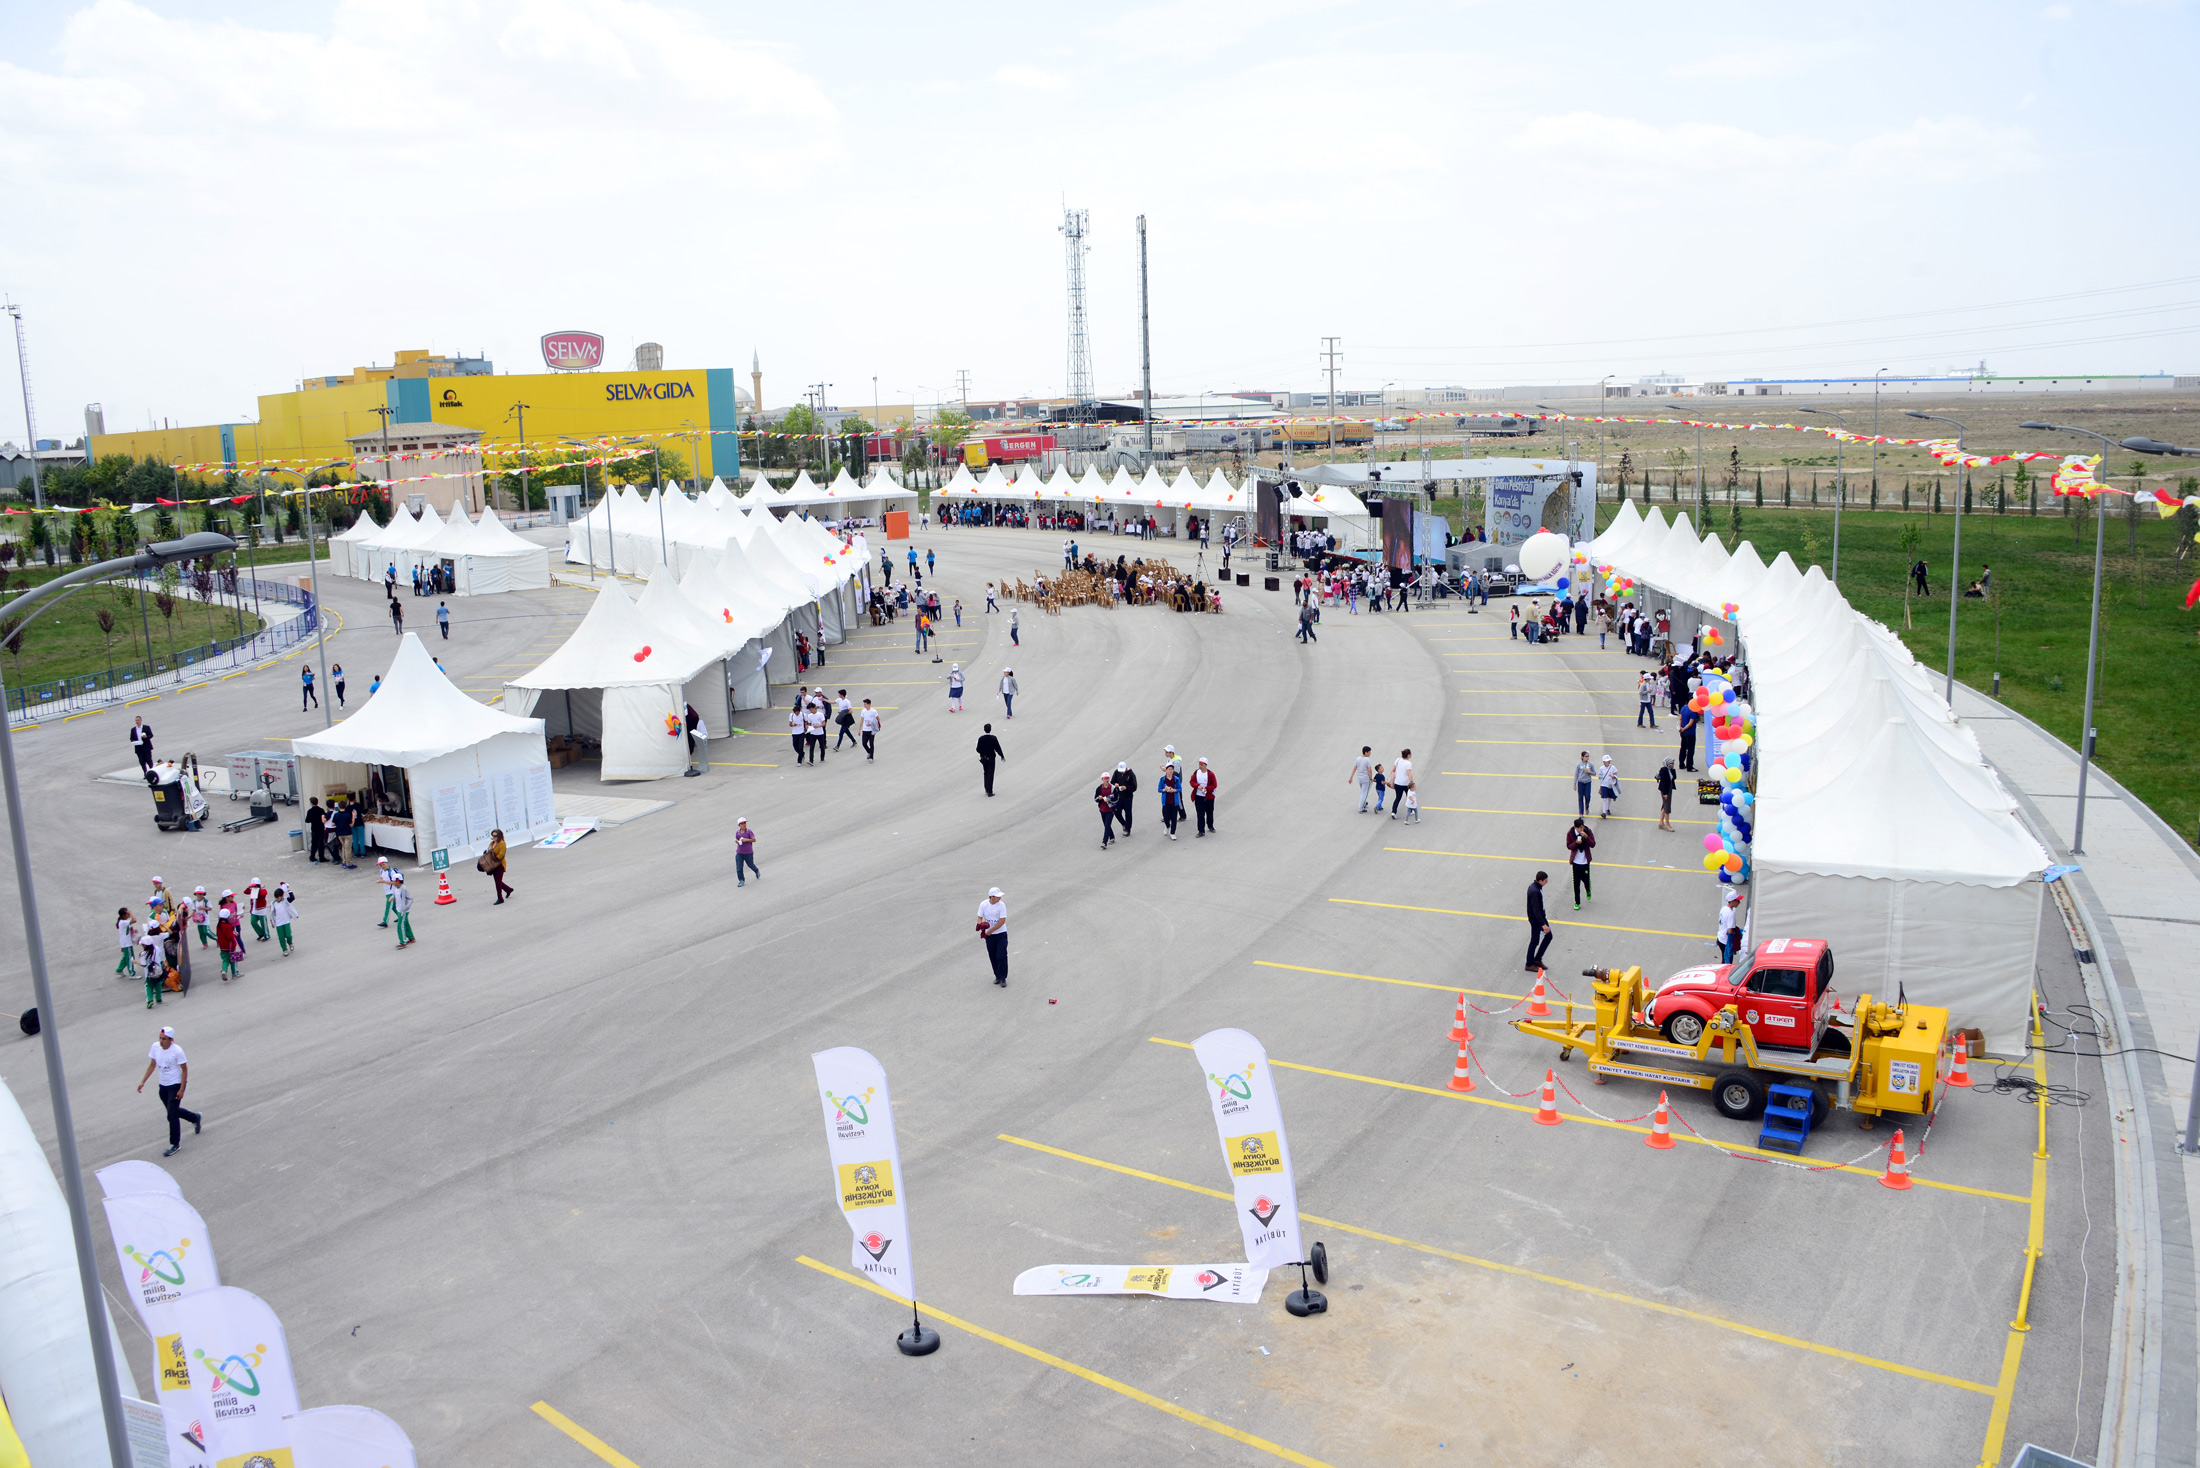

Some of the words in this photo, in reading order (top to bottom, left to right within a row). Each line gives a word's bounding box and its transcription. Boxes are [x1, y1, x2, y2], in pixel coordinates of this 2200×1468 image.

[548, 341, 598, 360] SELVA
[606, 383, 653, 402] SELVA
[653, 381, 695, 400] GIDA
